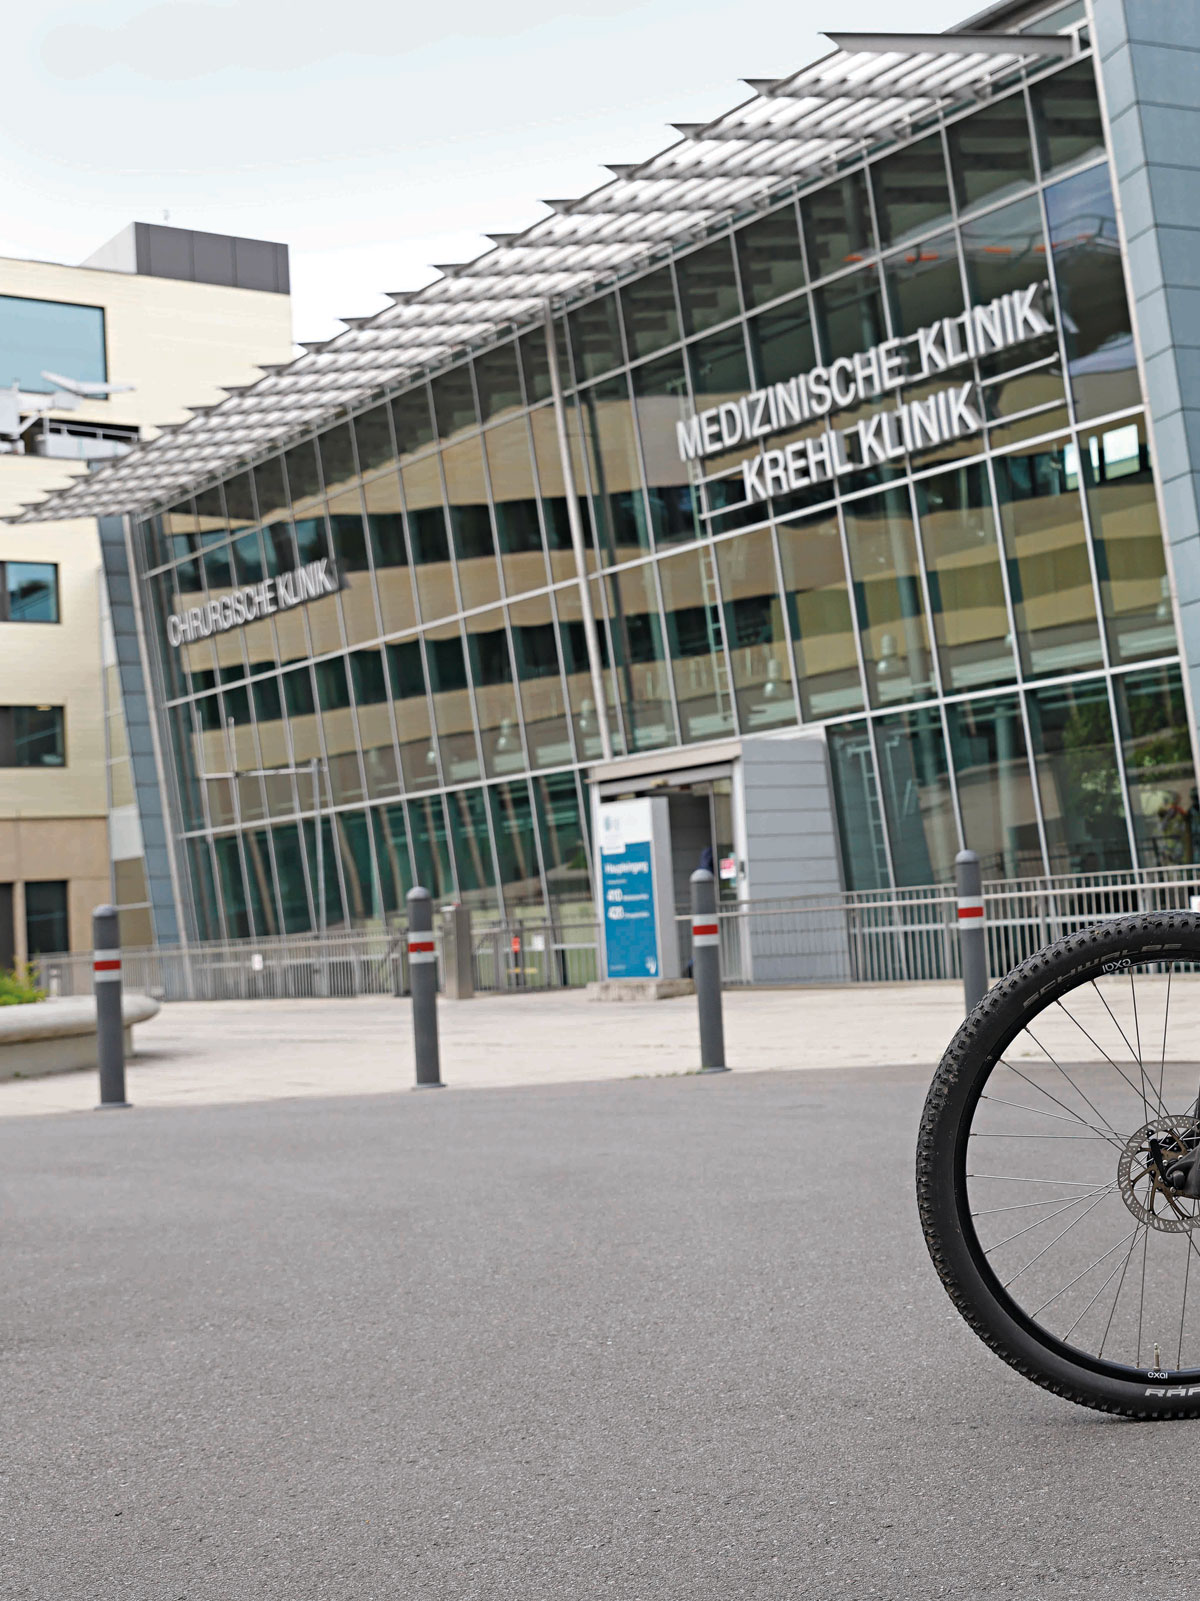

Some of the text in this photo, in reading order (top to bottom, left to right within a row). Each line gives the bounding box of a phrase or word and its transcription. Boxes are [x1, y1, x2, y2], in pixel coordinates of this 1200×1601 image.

[676, 281, 1055, 462] MEDIZINISCHE KLINIK
[742, 381, 981, 502] KREHL KLINIK
[166, 557, 335, 648] CHIRURGISCHE KLINIK
